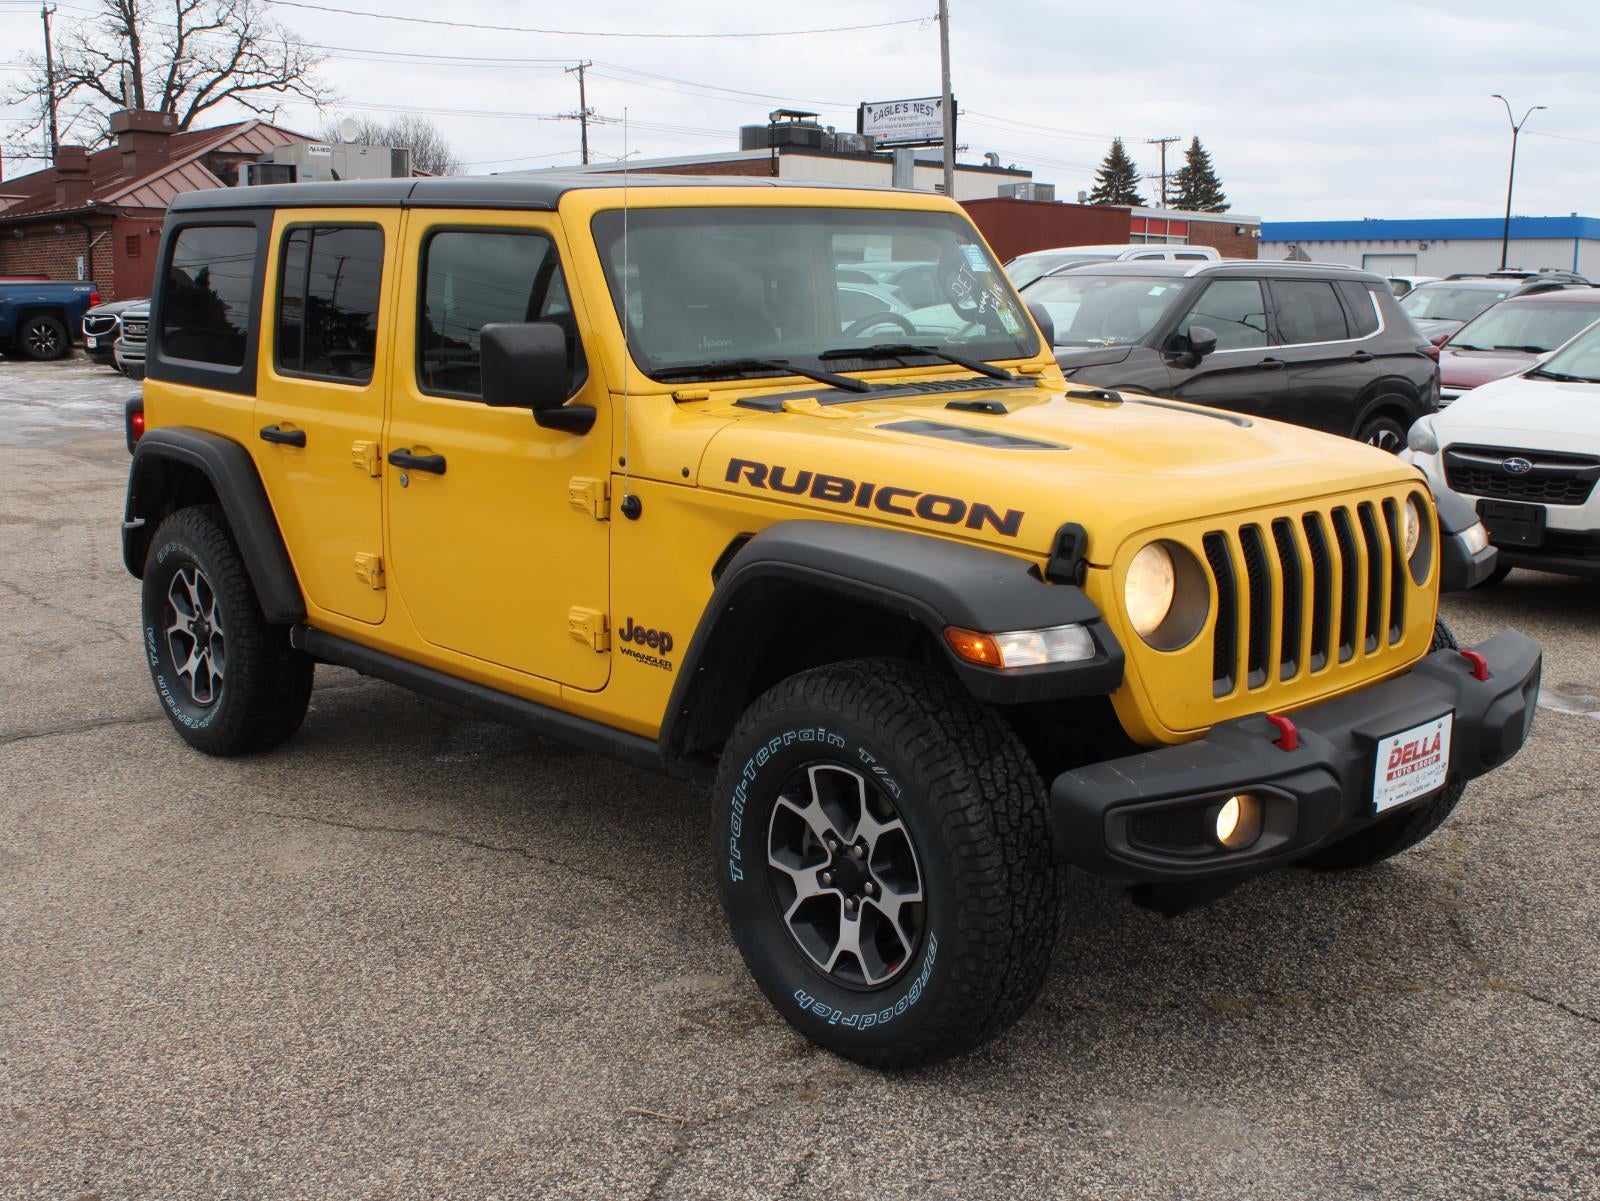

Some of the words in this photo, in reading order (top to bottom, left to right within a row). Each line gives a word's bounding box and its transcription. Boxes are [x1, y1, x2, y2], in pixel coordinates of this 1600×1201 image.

[873, 103, 909, 123] EAGLE'S
[913, 103, 934, 117] NEST
[724, 457, 1025, 538] RUBICON
[618, 616, 673, 656] Jeep
[620, 646, 672, 669] WRANGLER
[1387, 731, 1441, 770] DELLA
[1391, 765, 1412, 780] AUTO
[1414, 756, 1437, 770] GROUP
[728, 727, 846, 882] Trail-Terrain
[858, 748, 901, 799] T/A
[794, 931, 938, 1031] BFGoodrich
